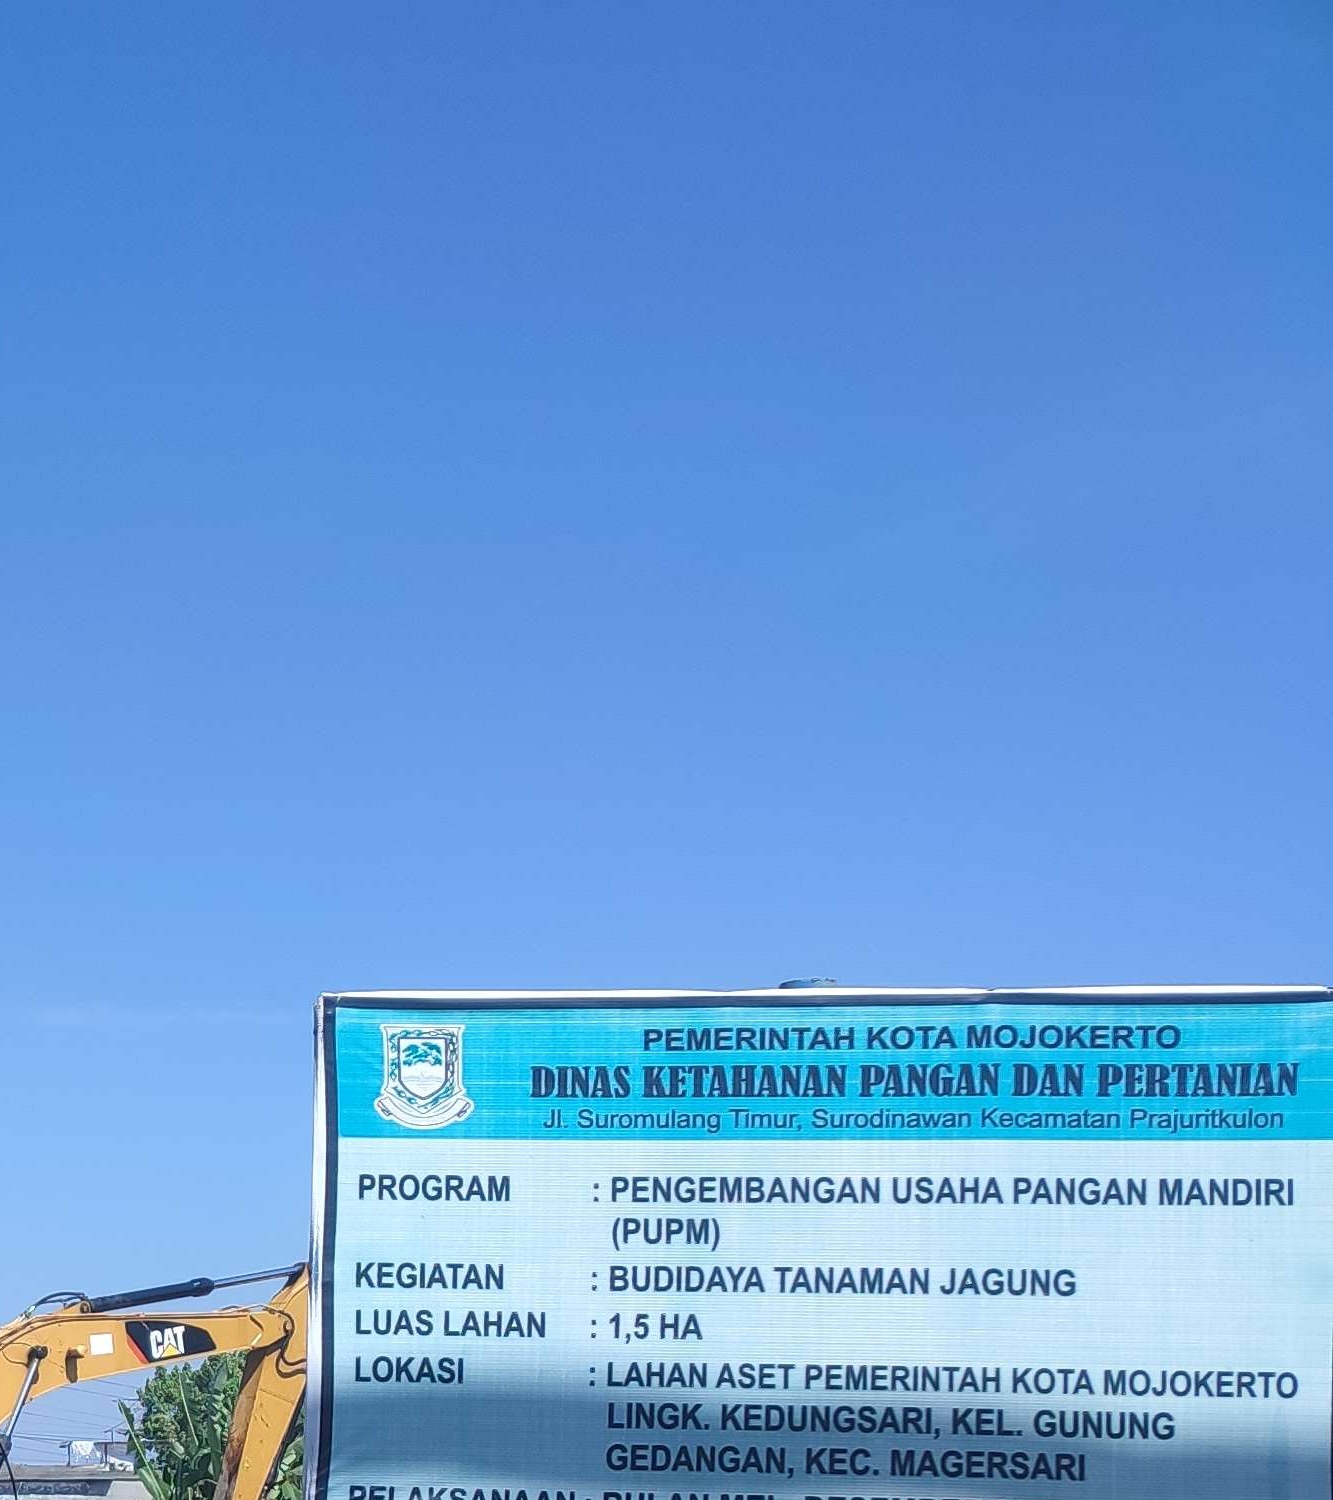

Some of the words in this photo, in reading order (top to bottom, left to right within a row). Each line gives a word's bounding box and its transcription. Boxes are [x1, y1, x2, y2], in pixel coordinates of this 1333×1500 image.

[643, 1026, 855, 1052] PEMERINTAH
[866, 1025, 959, 1050] KOTA
[966, 1024, 1182, 1050] MOJOKERTO
[529, 1065, 631, 1099] DINAS
[641, 1064, 848, 1099] KETAHANAN
[858, 1062, 1002, 1098] PANGAN
[1011, 1063, 1086, 1097] DAN
[1095, 1062, 1301, 1098] PERTANIAN
[542, 1108, 569, 1129] Jl.
[577, 1108, 722, 1134] Suromulang
[727, 1108, 802, 1132] Timur,
[811, 1107, 972, 1129] Surodinawan
[980, 1107, 1121, 1129] Kecamatan
[1129, 1107, 1284, 1135] Prajuritkulon
[358, 1173, 511, 1202] PROGRAM
[611, 1176, 881, 1204] PENGEMBANGAN
[892, 1176, 1004, 1205] USAHA
[1013, 1177, 1147, 1206] PANGAN
[1158, 1178, 1294, 1206] MANDIRI
[612, 1217, 720, 1253] (PUPM)
[355, 1261, 504, 1290] KEGIATAN
[609, 1265, 766, 1293] BUDIDAYA
[773, 1266, 930, 1295] TANAMAN
[939, 1267, 1076, 1297] JAGUNG
[149, 1325, 185, 1359] CAT
[355, 1308, 434, 1336] LUAS
[443, 1310, 546, 1338] LAHAN
[609, 1312, 650, 1345] 1,5
[659, 1313, 703, 1341] HA
[354, 1355, 464, 1385] LOKASI
[606, 1361, 707, 1388] LAHAN
[714, 1362, 796, 1390] ASET
[804, 1364, 1001, 1393] PEMERINTAH
[1011, 1367, 1095, 1395] KOTA
[1103, 1369, 1299, 1399] MOJOKERTO
[607, 1402, 710, 1431] LINGK.
[719, 1403, 942, 1441] KEDUNGSARI,
[949, 1407, 1024, 1437] KEL.
[1032, 1411, 1177, 1440] GUNUNG
[605, 1443, 795, 1479] GEDANGAN,
[805, 1447, 880, 1476] KEC.
[889, 1449, 1086, 1482] MAGERSARI
